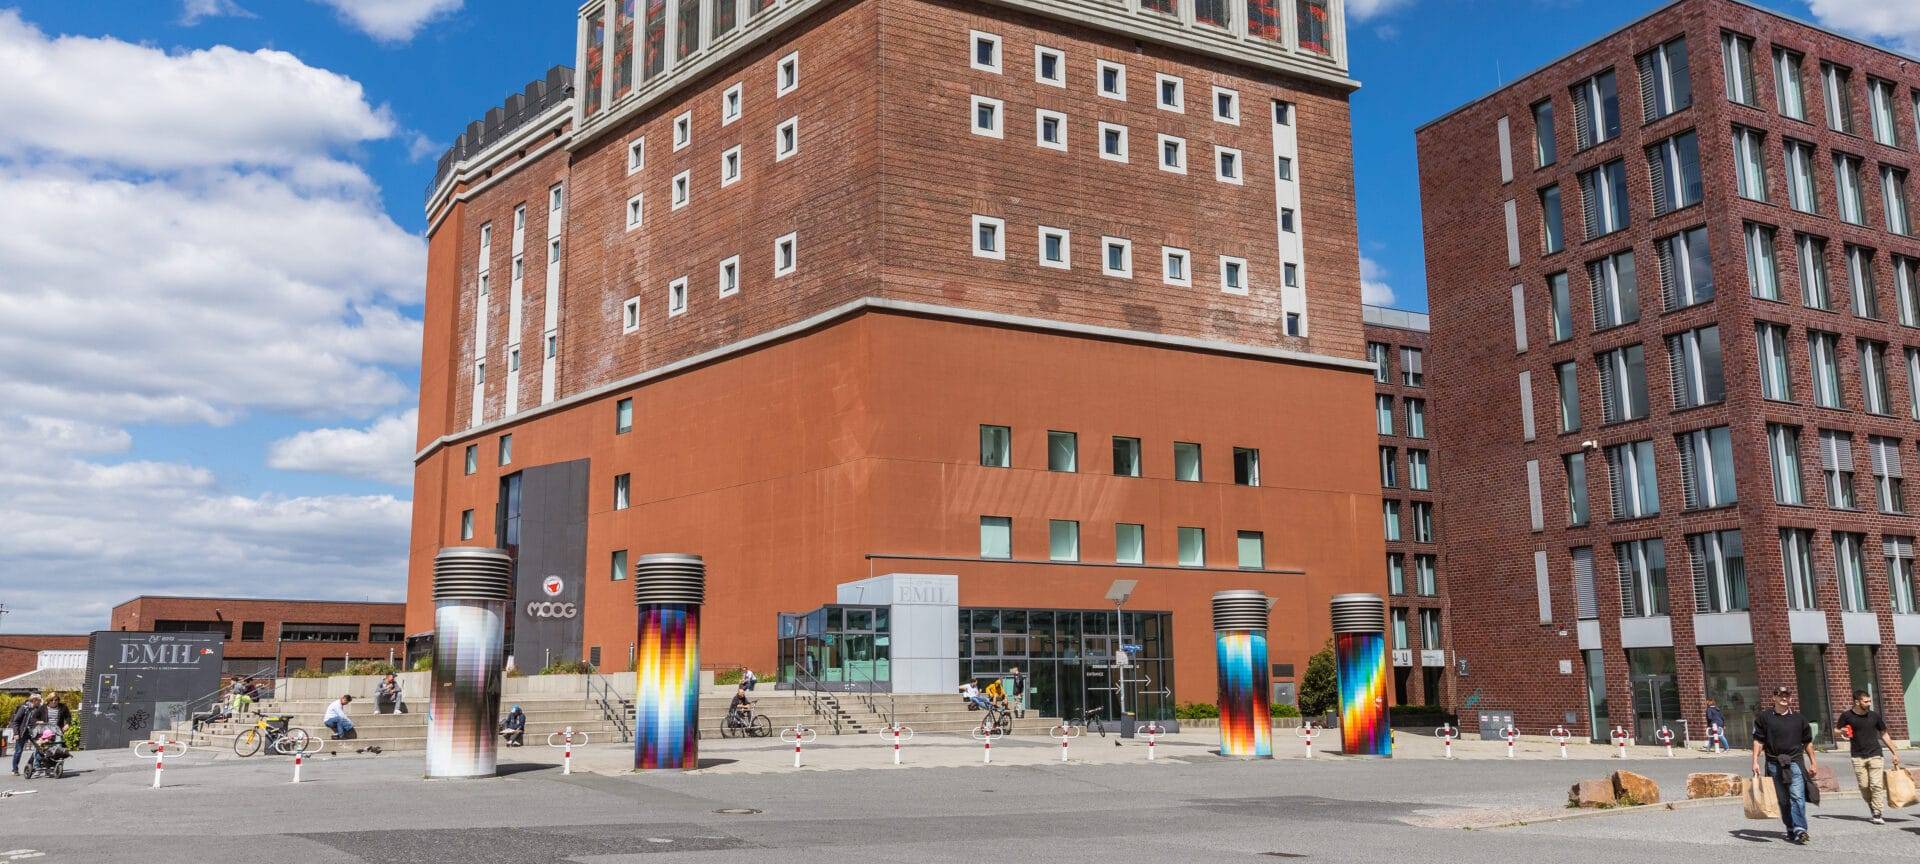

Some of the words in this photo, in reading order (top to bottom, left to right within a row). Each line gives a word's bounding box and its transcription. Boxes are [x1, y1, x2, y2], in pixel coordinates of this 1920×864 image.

[898, 586, 949, 602] EMIL
[527, 601, 577, 618] MOOG
[119, 643, 200, 664] EMIL
